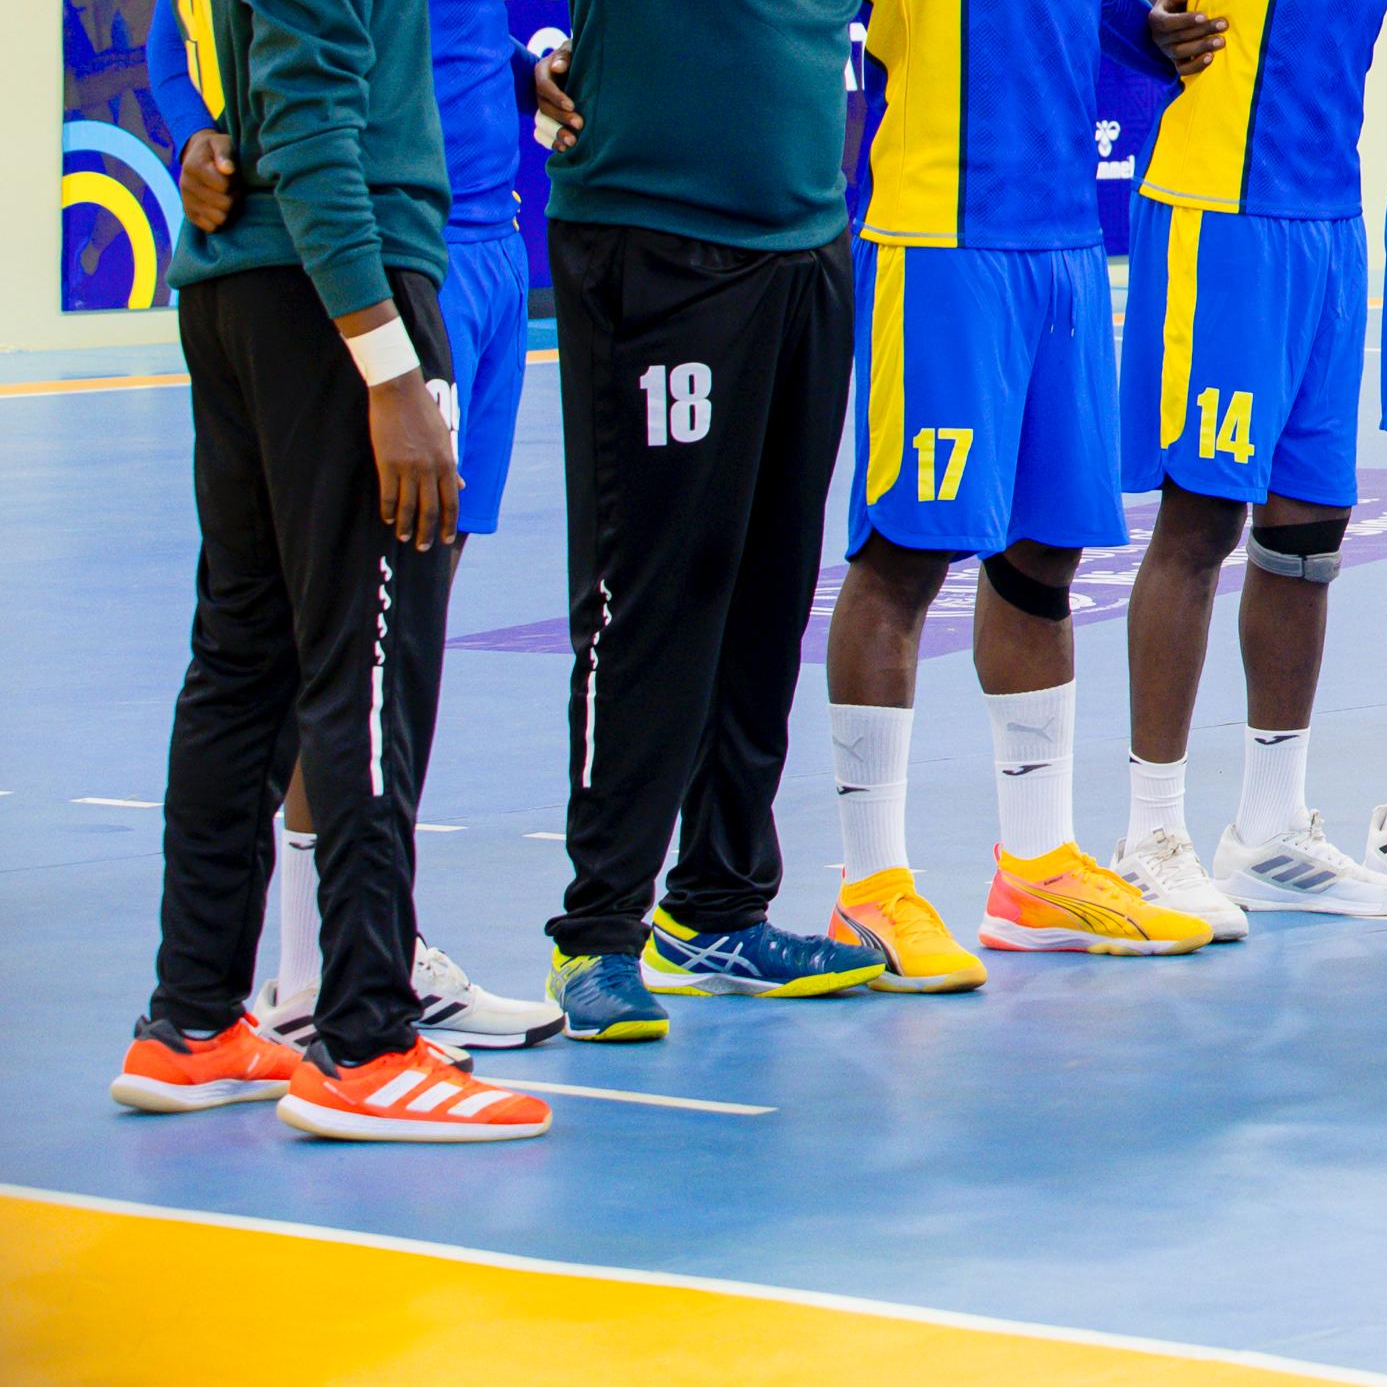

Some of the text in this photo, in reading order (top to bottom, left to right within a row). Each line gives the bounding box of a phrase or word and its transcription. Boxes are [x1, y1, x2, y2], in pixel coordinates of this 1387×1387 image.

[640, 362, 712, 446] 18
[1196, 387, 1255, 464] 14
[912, 427, 974, 502] 17
